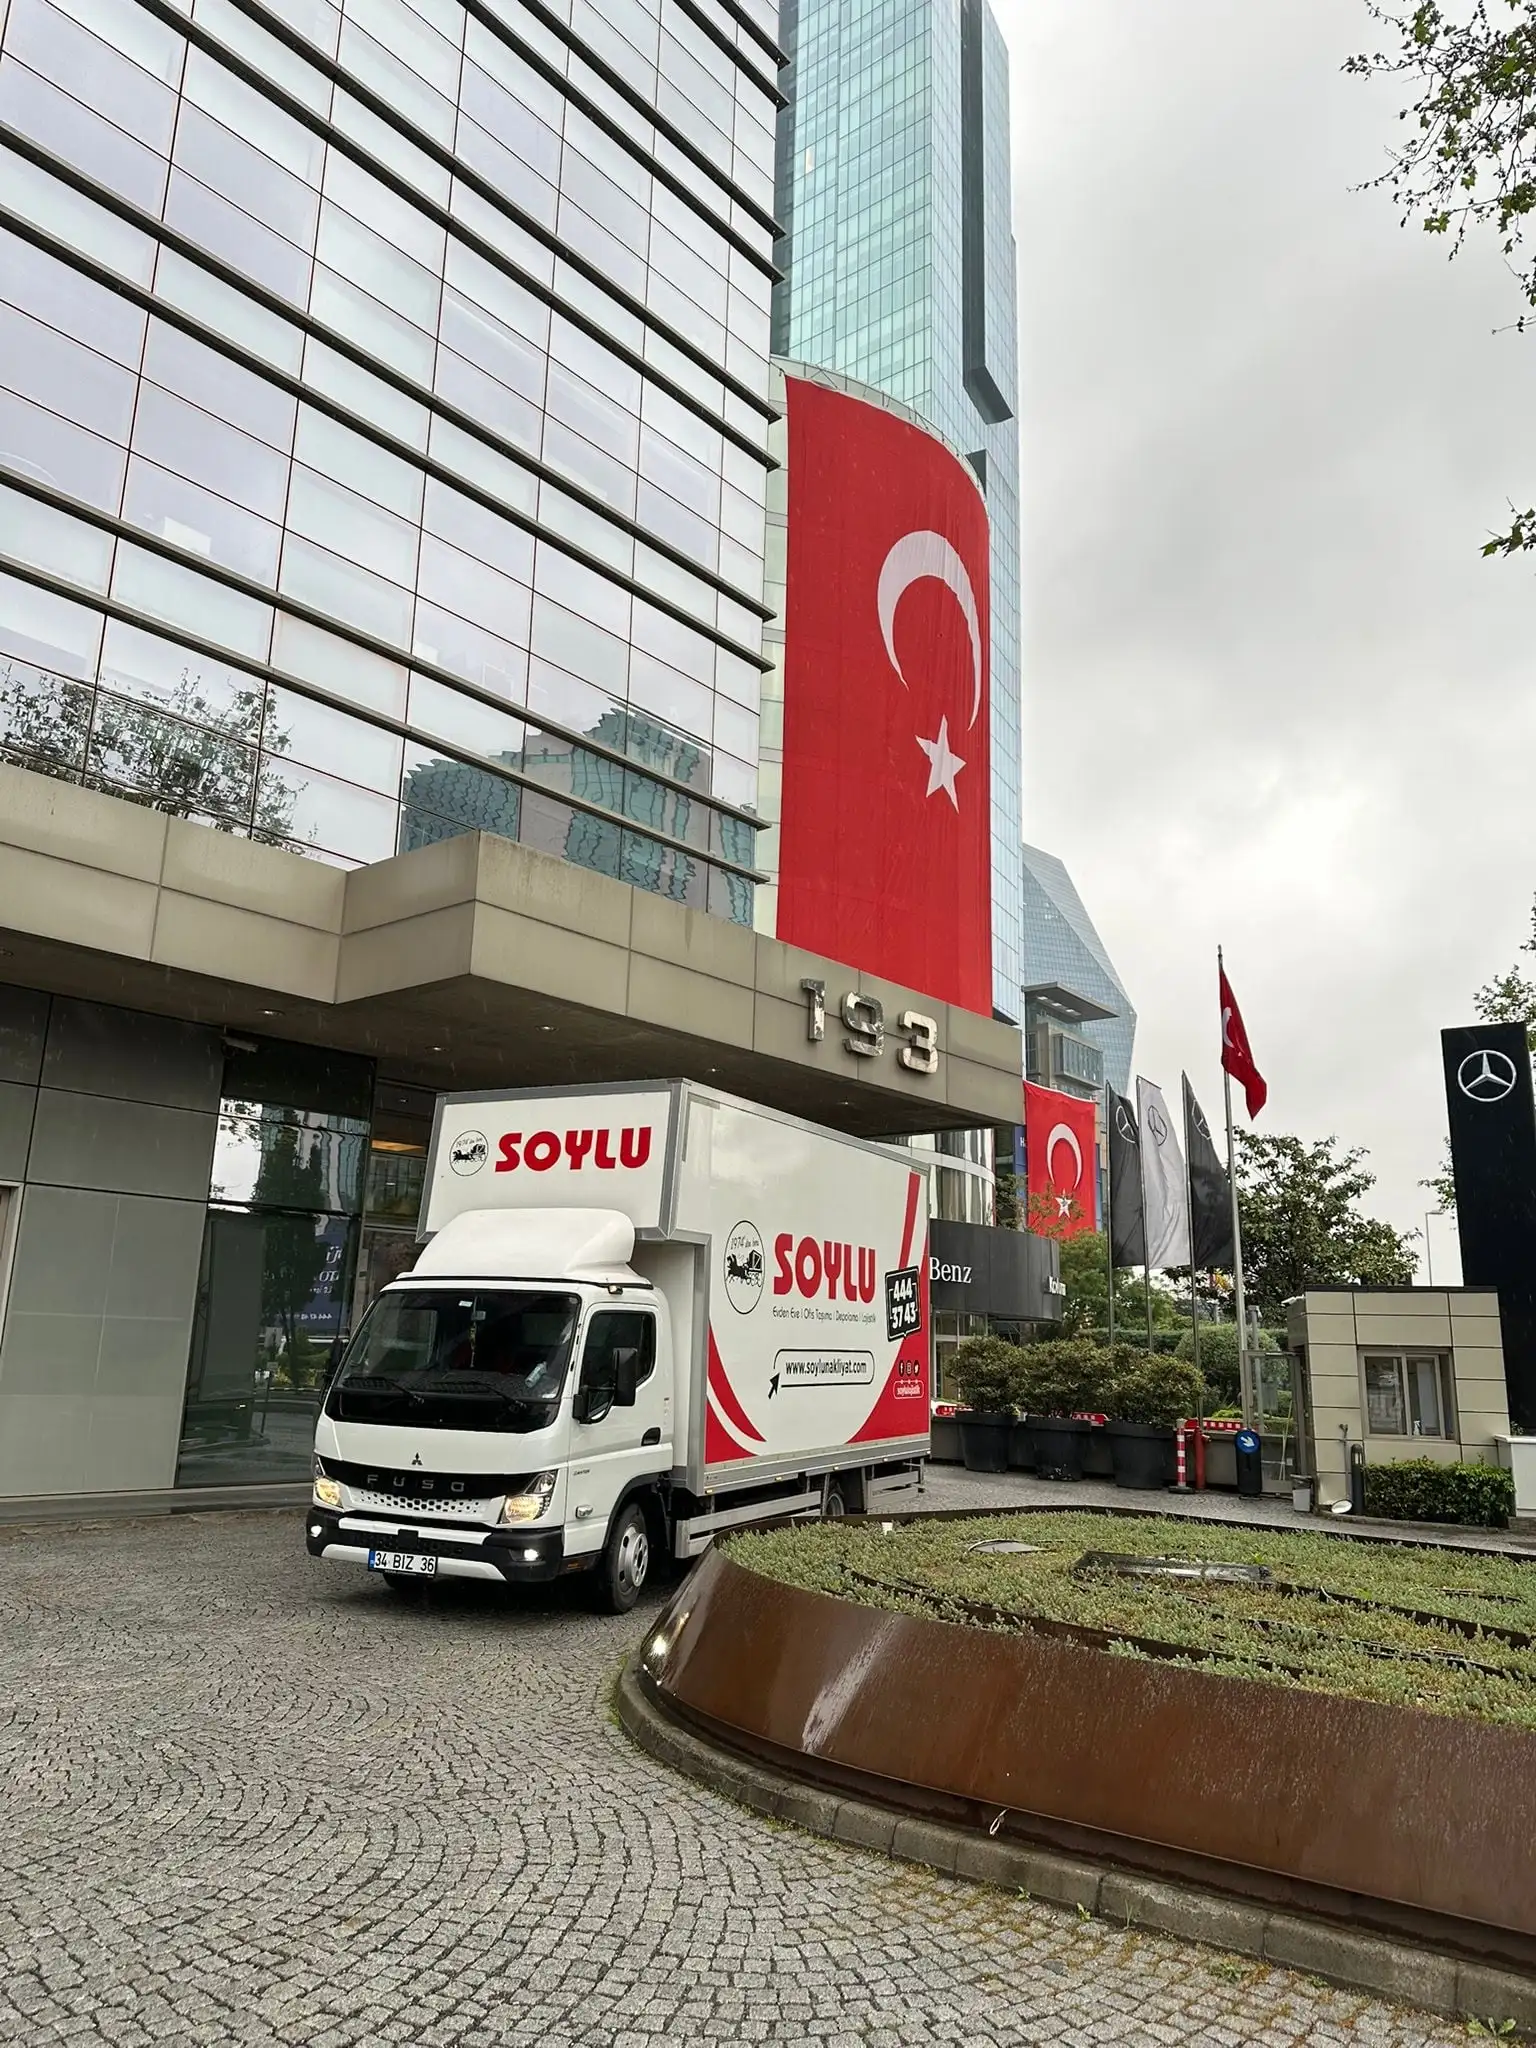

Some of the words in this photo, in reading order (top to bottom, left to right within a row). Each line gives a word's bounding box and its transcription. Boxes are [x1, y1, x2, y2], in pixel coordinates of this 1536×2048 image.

[800, 978, 939, 1074] 193
[495, 1126, 652, 1173] SOYLU
[773, 1233, 876, 1304] SOYLU
[929, 1256, 972, 1284] Benz
[893, 1277, 913, 1301] 444
[772, 1305, 790, 1319] Evden
[790, 1306, 800, 1319] Eve
[785, 1358, 867, 1377] www.soylunakliyat.com
[367, 1474, 465, 1493] FUSO
[374, 1551, 387, 1568] 34
[393, 1555, 414, 1571] BIZ
[420, 1556, 435, 1573] 36
